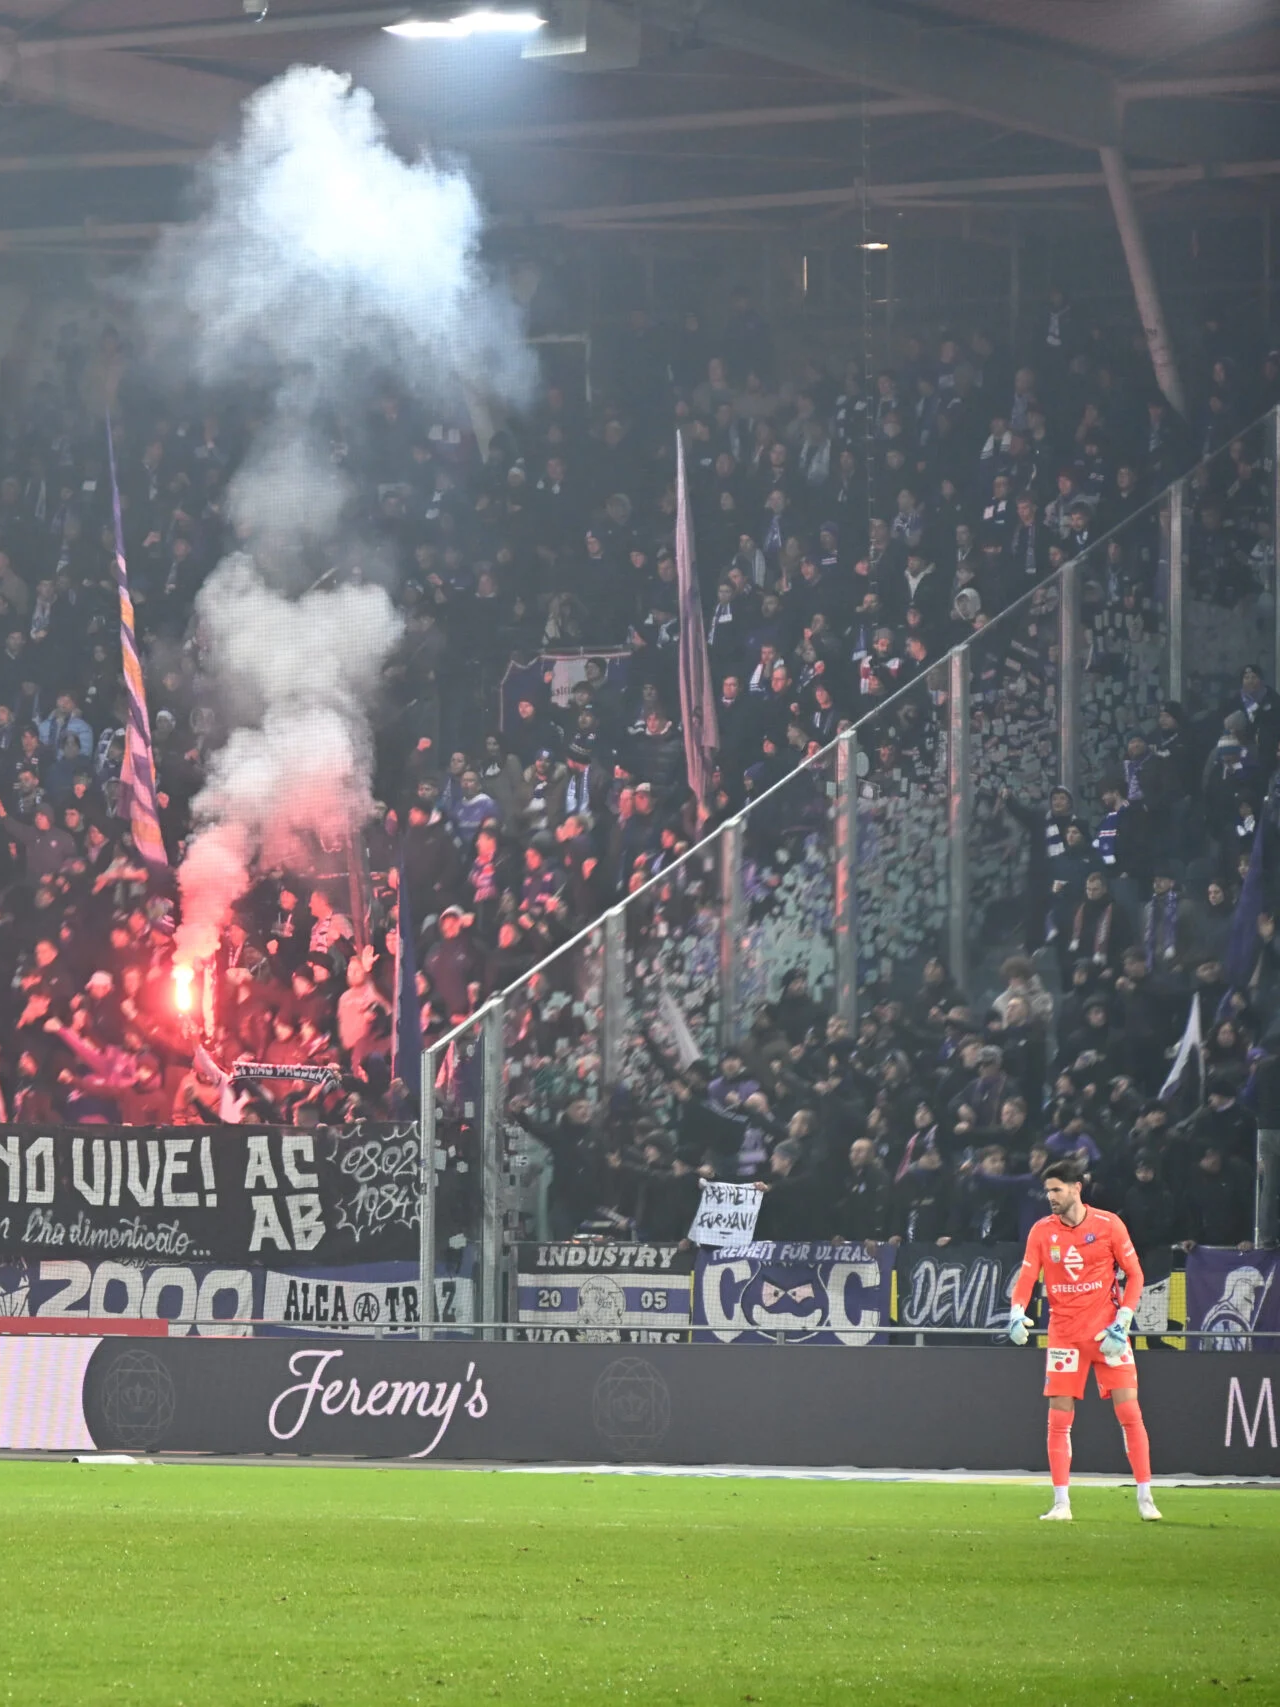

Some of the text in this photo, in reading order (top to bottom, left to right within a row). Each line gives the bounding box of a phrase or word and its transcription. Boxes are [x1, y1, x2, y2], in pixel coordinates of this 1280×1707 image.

[72, 1136, 218, 1208] VIVE!
[348, 1183, 413, 1226] 1984
[536, 1245, 678, 1268] INDUSTRY
[36, 1260, 254, 1336] 2000
[538, 1289, 562, 1308] 20
[641, 1291, 667, 1310] 05
[1051, 1281, 1103, 1294] STEELCOIN
[268, 1349, 489, 1459] Jeremy's
